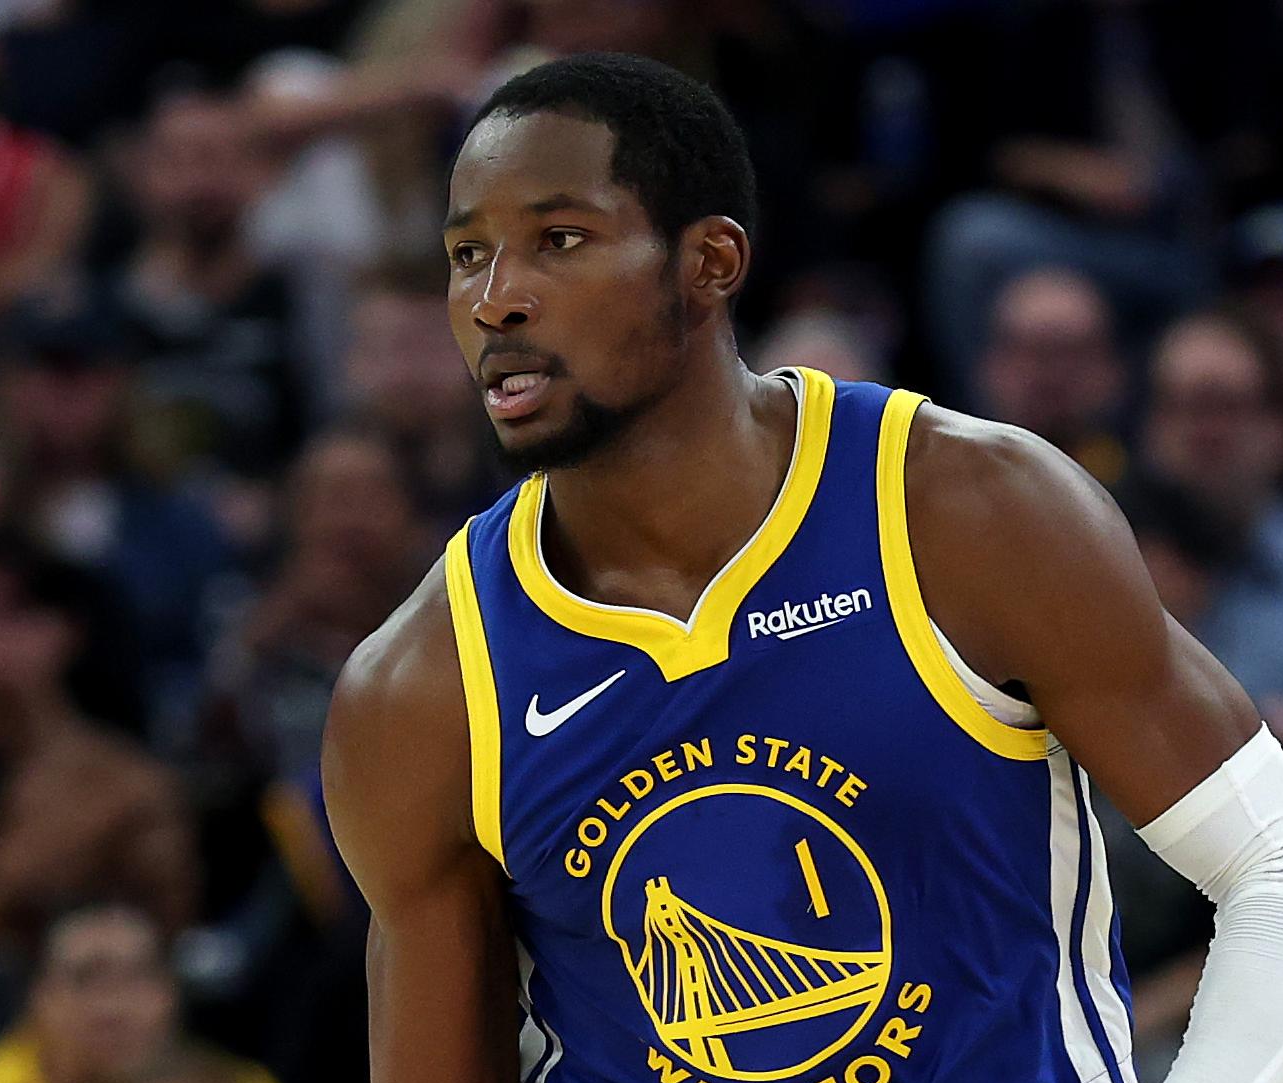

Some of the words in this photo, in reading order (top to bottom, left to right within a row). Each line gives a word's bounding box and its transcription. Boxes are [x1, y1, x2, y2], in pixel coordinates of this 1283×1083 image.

[746, 587, 873, 640] Rakuten
[564, 737, 714, 879] GOLDEN
[735, 734, 868, 808] STATE
[794, 838, 830, 919] 1
